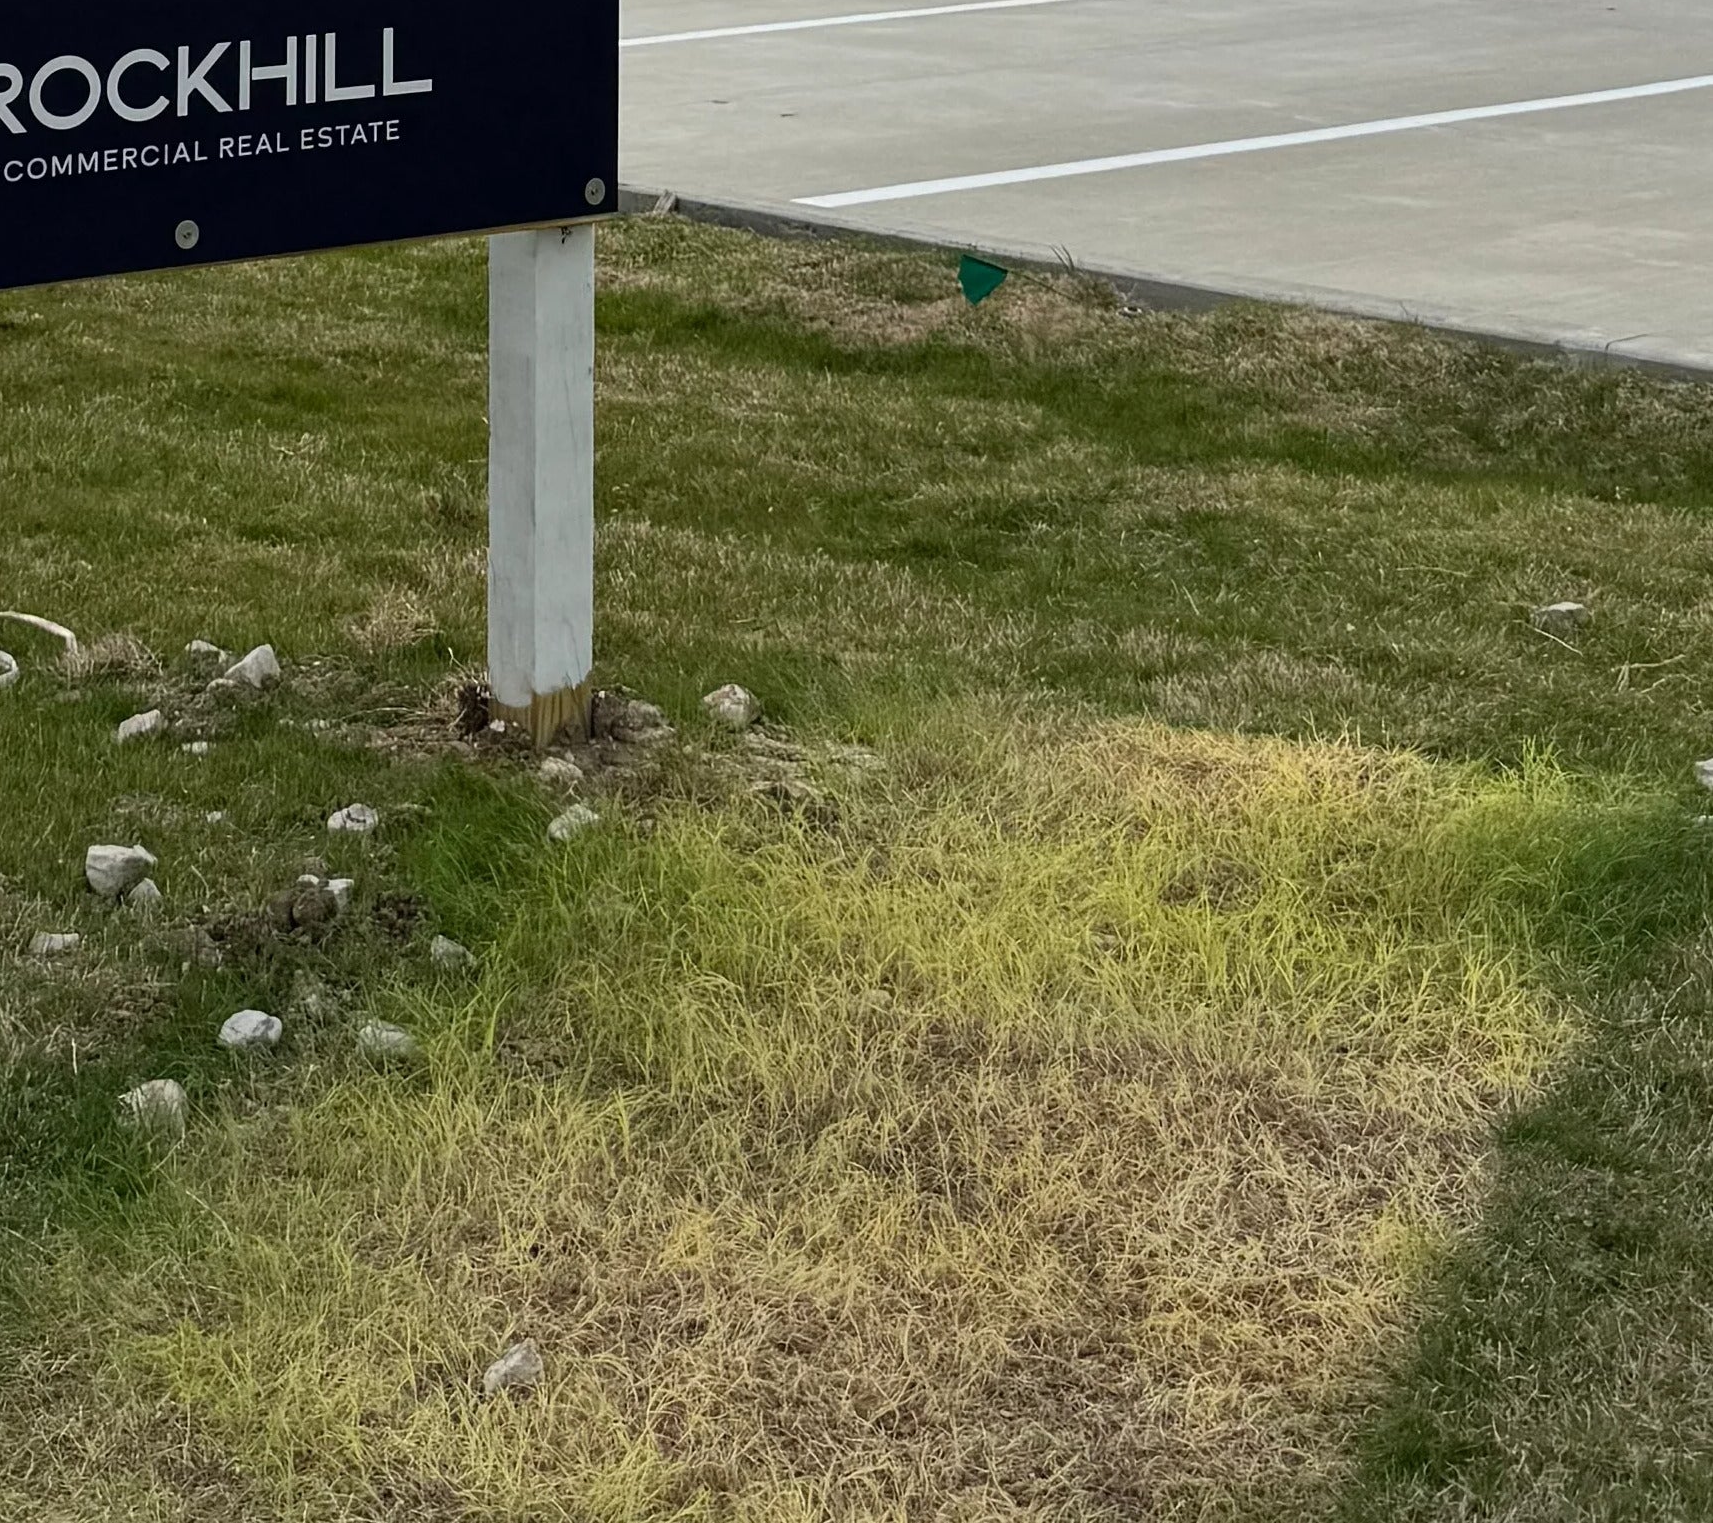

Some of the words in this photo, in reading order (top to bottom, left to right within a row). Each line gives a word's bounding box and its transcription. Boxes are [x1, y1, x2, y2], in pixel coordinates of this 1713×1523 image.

[3, 140, 208, 182] COMMERCIAL
[219, 132, 290, 159] REAL
[300, 119, 400, 150] ESTATE
